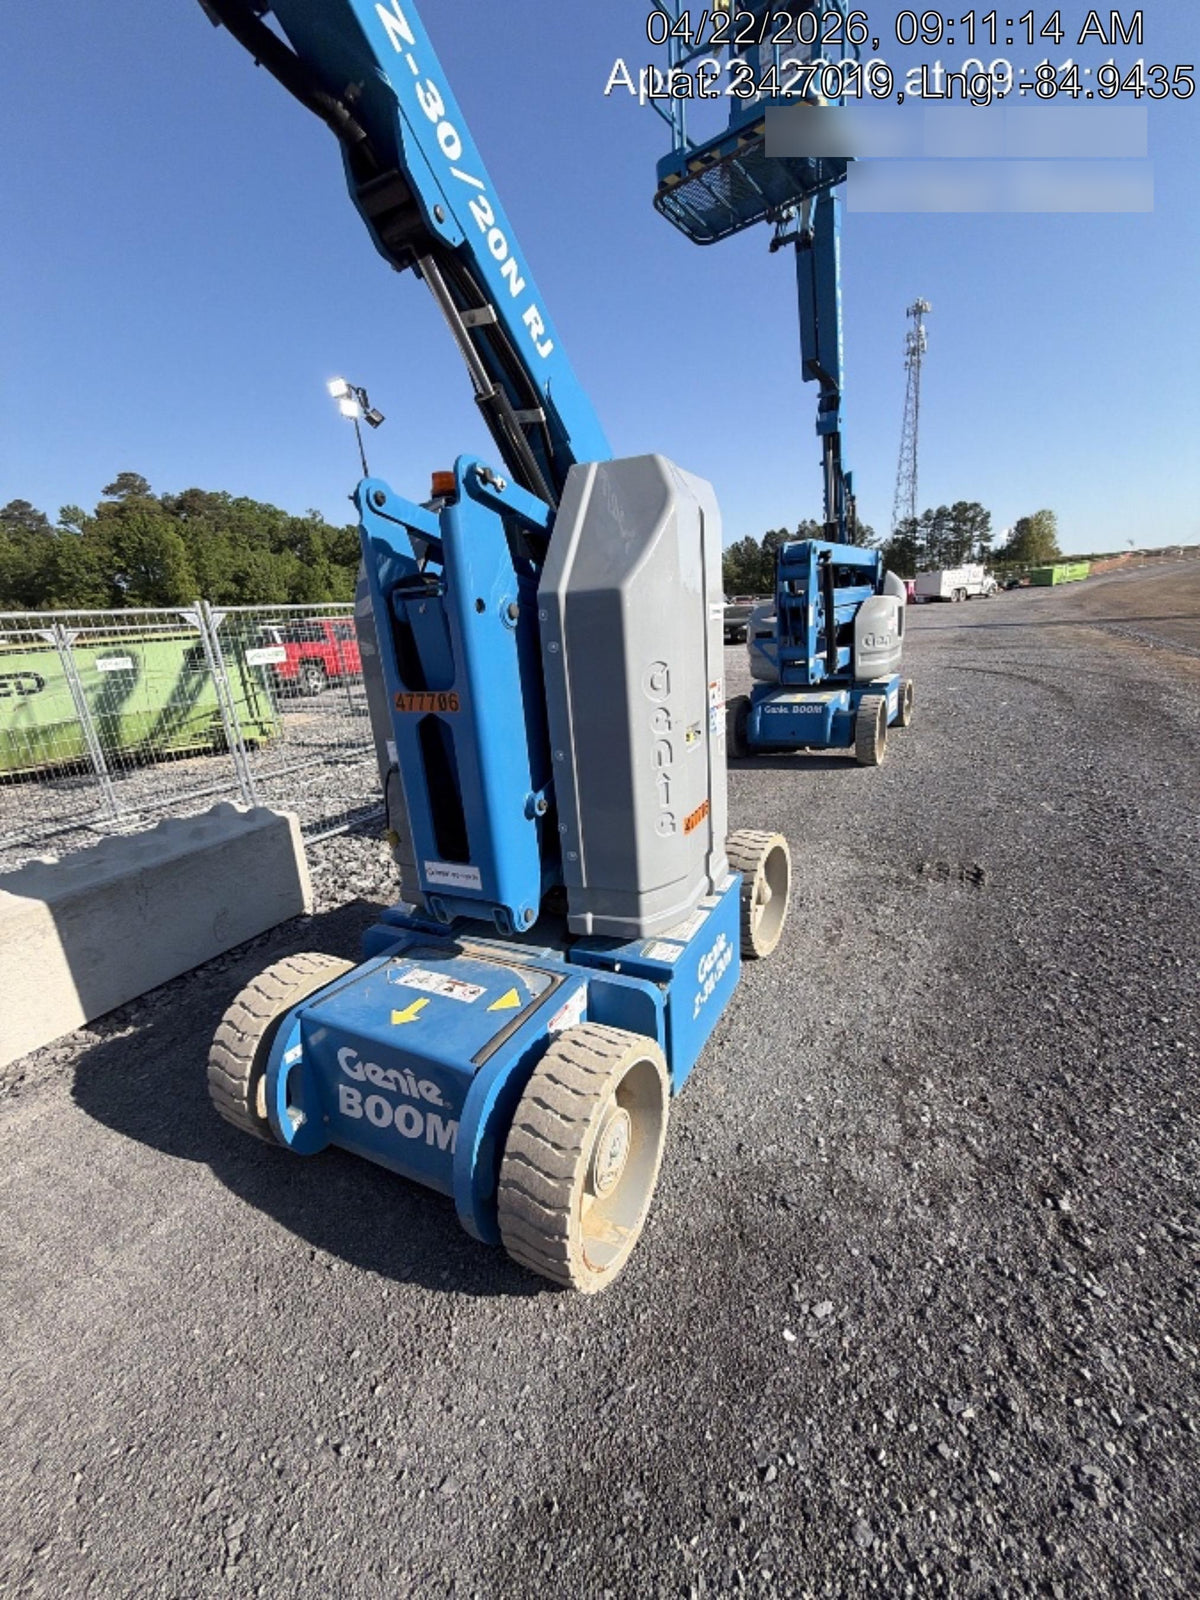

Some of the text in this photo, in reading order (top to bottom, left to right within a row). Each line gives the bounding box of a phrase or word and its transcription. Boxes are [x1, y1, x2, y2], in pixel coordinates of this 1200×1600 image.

[522, 304, 554, 359] RJ
[395, 692, 460, 712] 477706
[337, 1046, 444, 1107] Genie
[339, 1084, 460, 1155] BOOM
